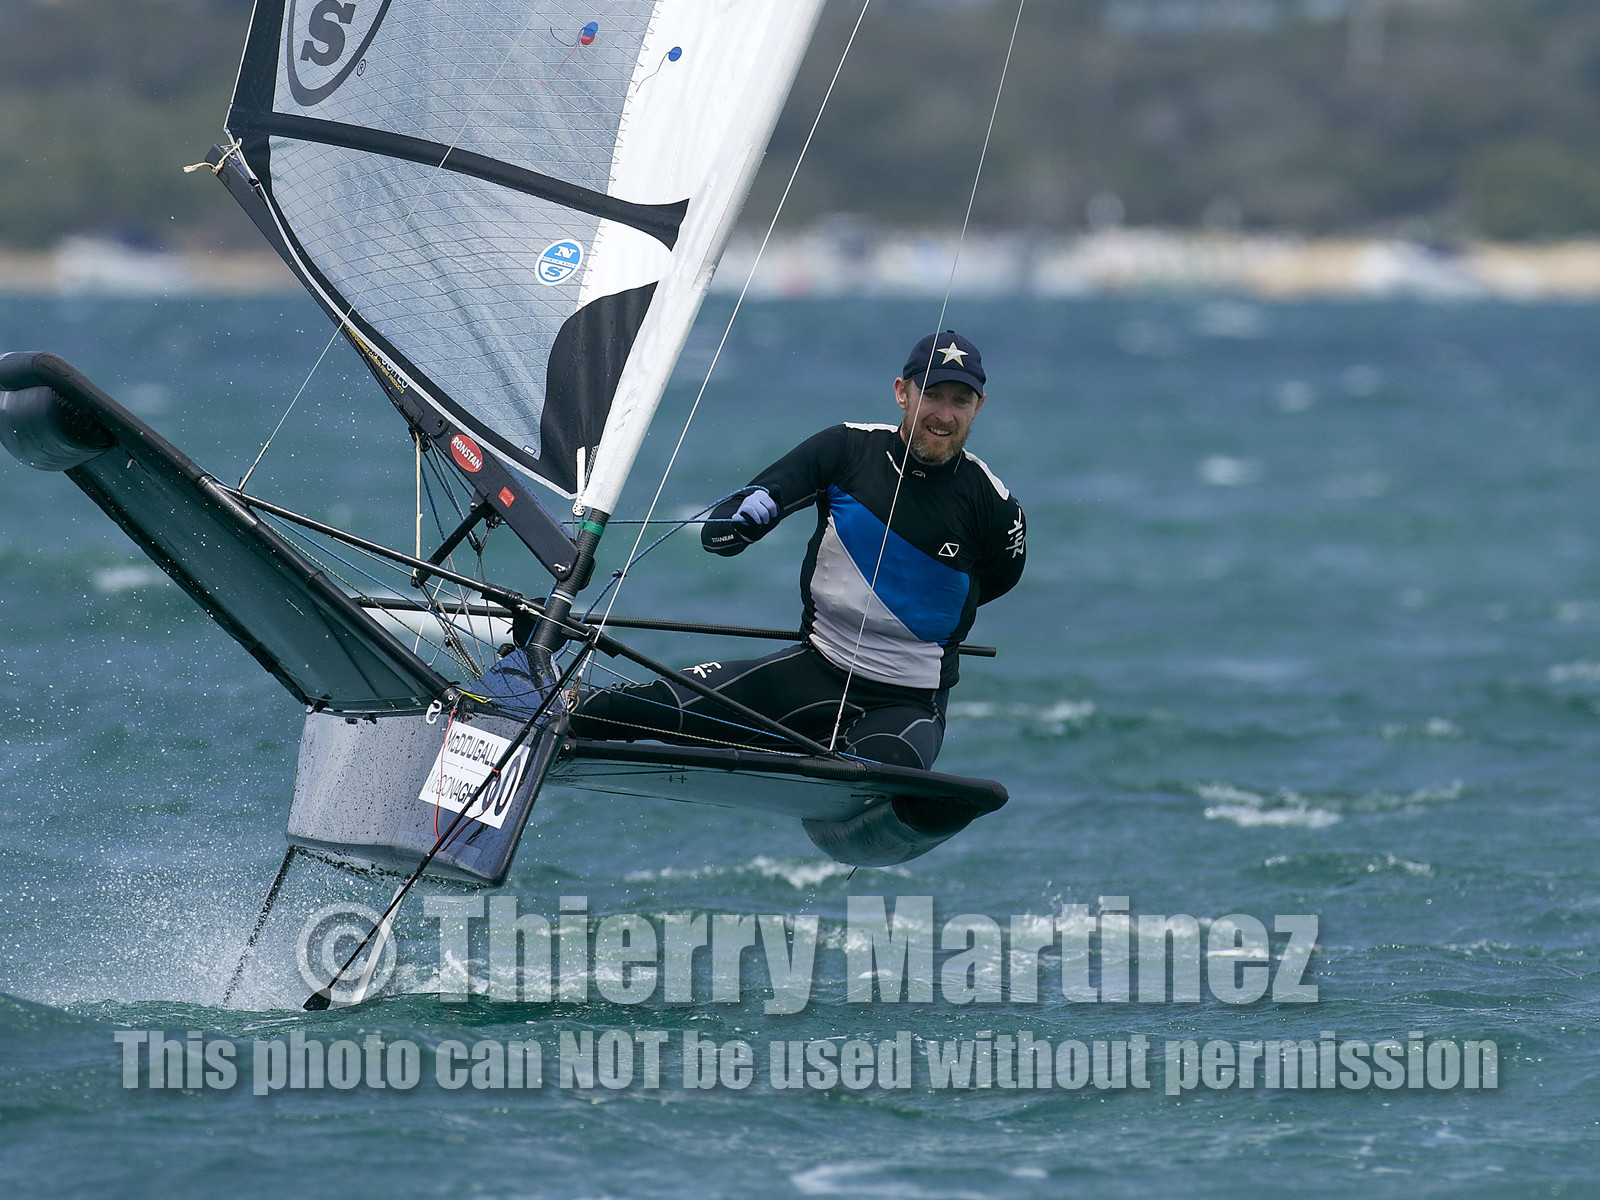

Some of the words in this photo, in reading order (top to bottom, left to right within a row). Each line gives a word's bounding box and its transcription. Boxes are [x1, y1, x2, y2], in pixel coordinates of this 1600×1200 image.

[300, 0, 357, 66] S
[554, 245, 577, 259] N
[545, 266, 563, 277] S
[451, 436, 482, 469] RONSTAN
[446, 730, 499, 767] McDOUGALL
